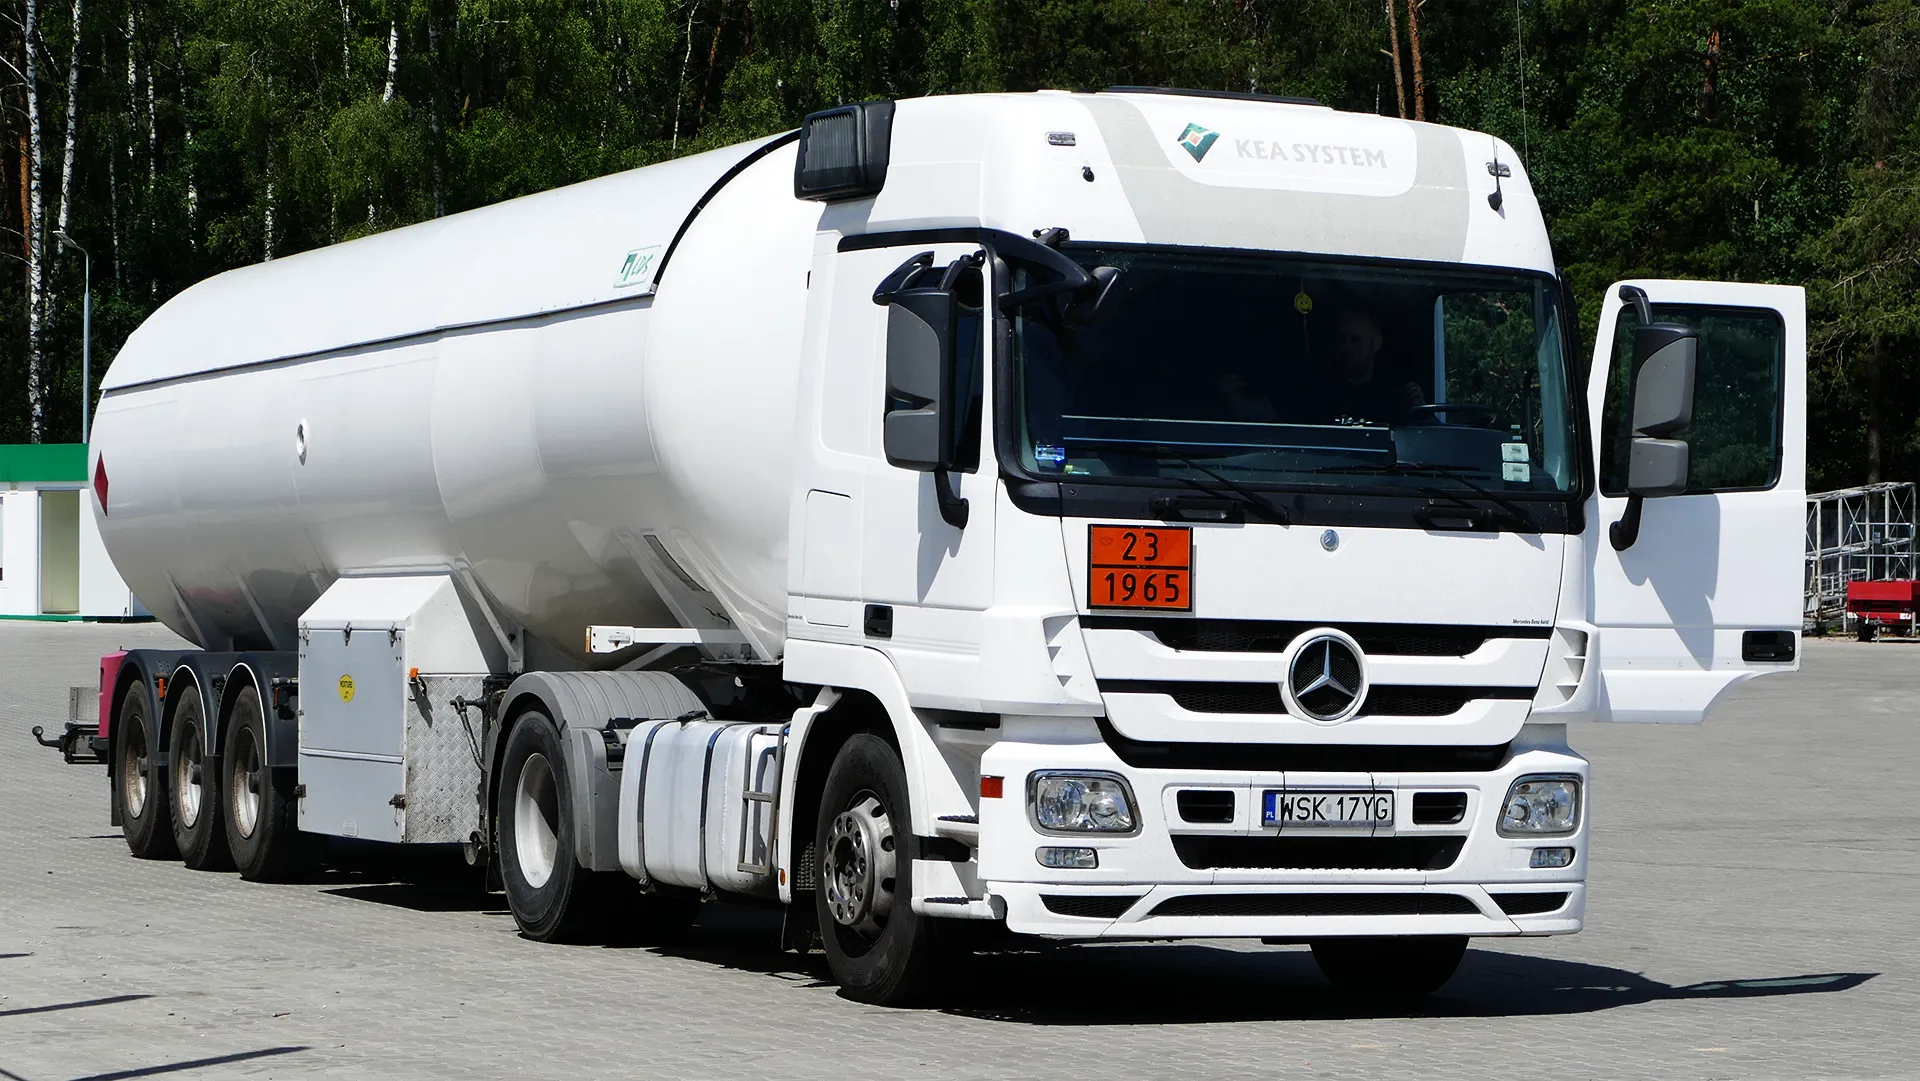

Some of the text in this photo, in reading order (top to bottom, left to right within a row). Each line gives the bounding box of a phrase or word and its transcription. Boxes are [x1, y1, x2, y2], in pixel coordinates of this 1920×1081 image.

[1235, 139, 1388, 169] KEA SYSTEM
[1123, 532, 1157, 560] 23
[1104, 573, 1179, 602] 1965
[1266, 811, 1275, 819] PL
[1280, 797, 1388, 820] WSK 17YG
